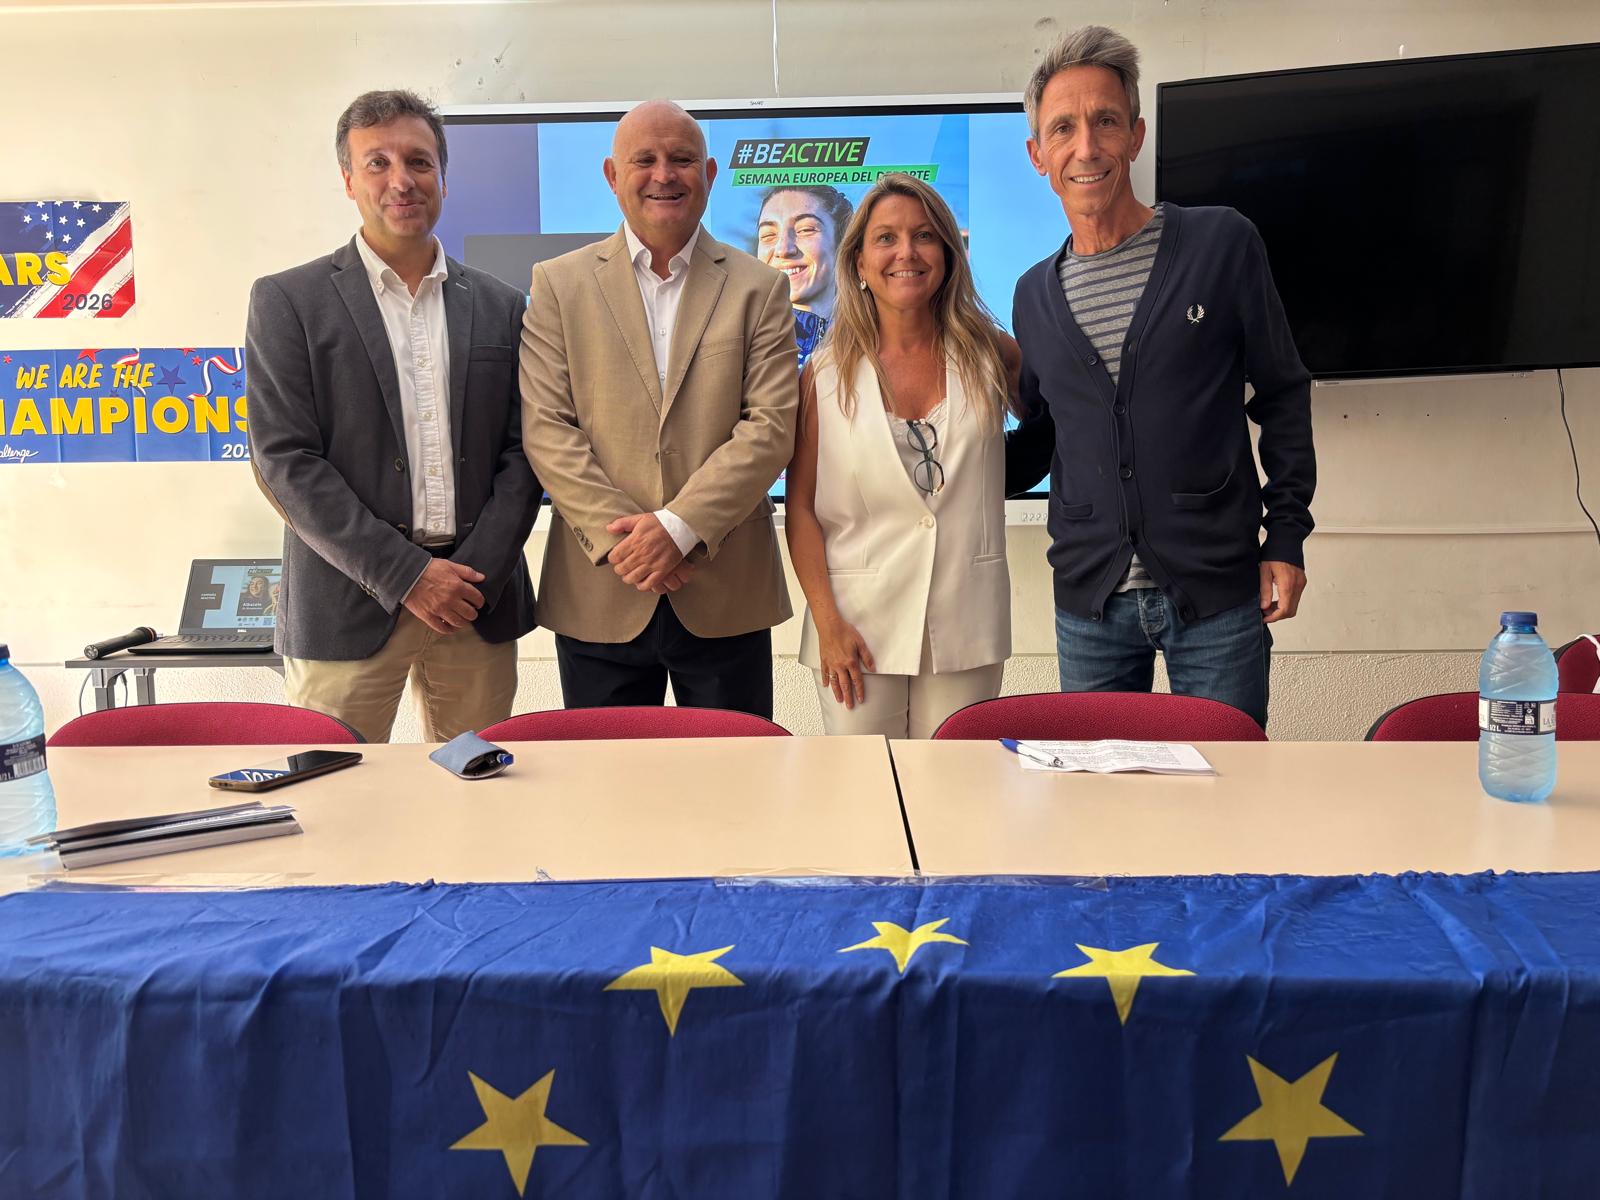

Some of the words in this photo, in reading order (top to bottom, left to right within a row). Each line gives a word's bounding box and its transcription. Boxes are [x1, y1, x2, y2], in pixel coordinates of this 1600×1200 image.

[738, 141, 864, 165] #BEACTIVE
[738, 173, 790, 185] SEMANA
[793, 172, 849, 183] EUROPEA
[851, 171, 873, 182] DEL
[62, 293, 113, 311] 2026
[15, 364, 50, 390] WE
[59, 363, 104, 389] ARE
[112, 362, 156, 388] THE
[0, 396, 247, 436] AMPION
